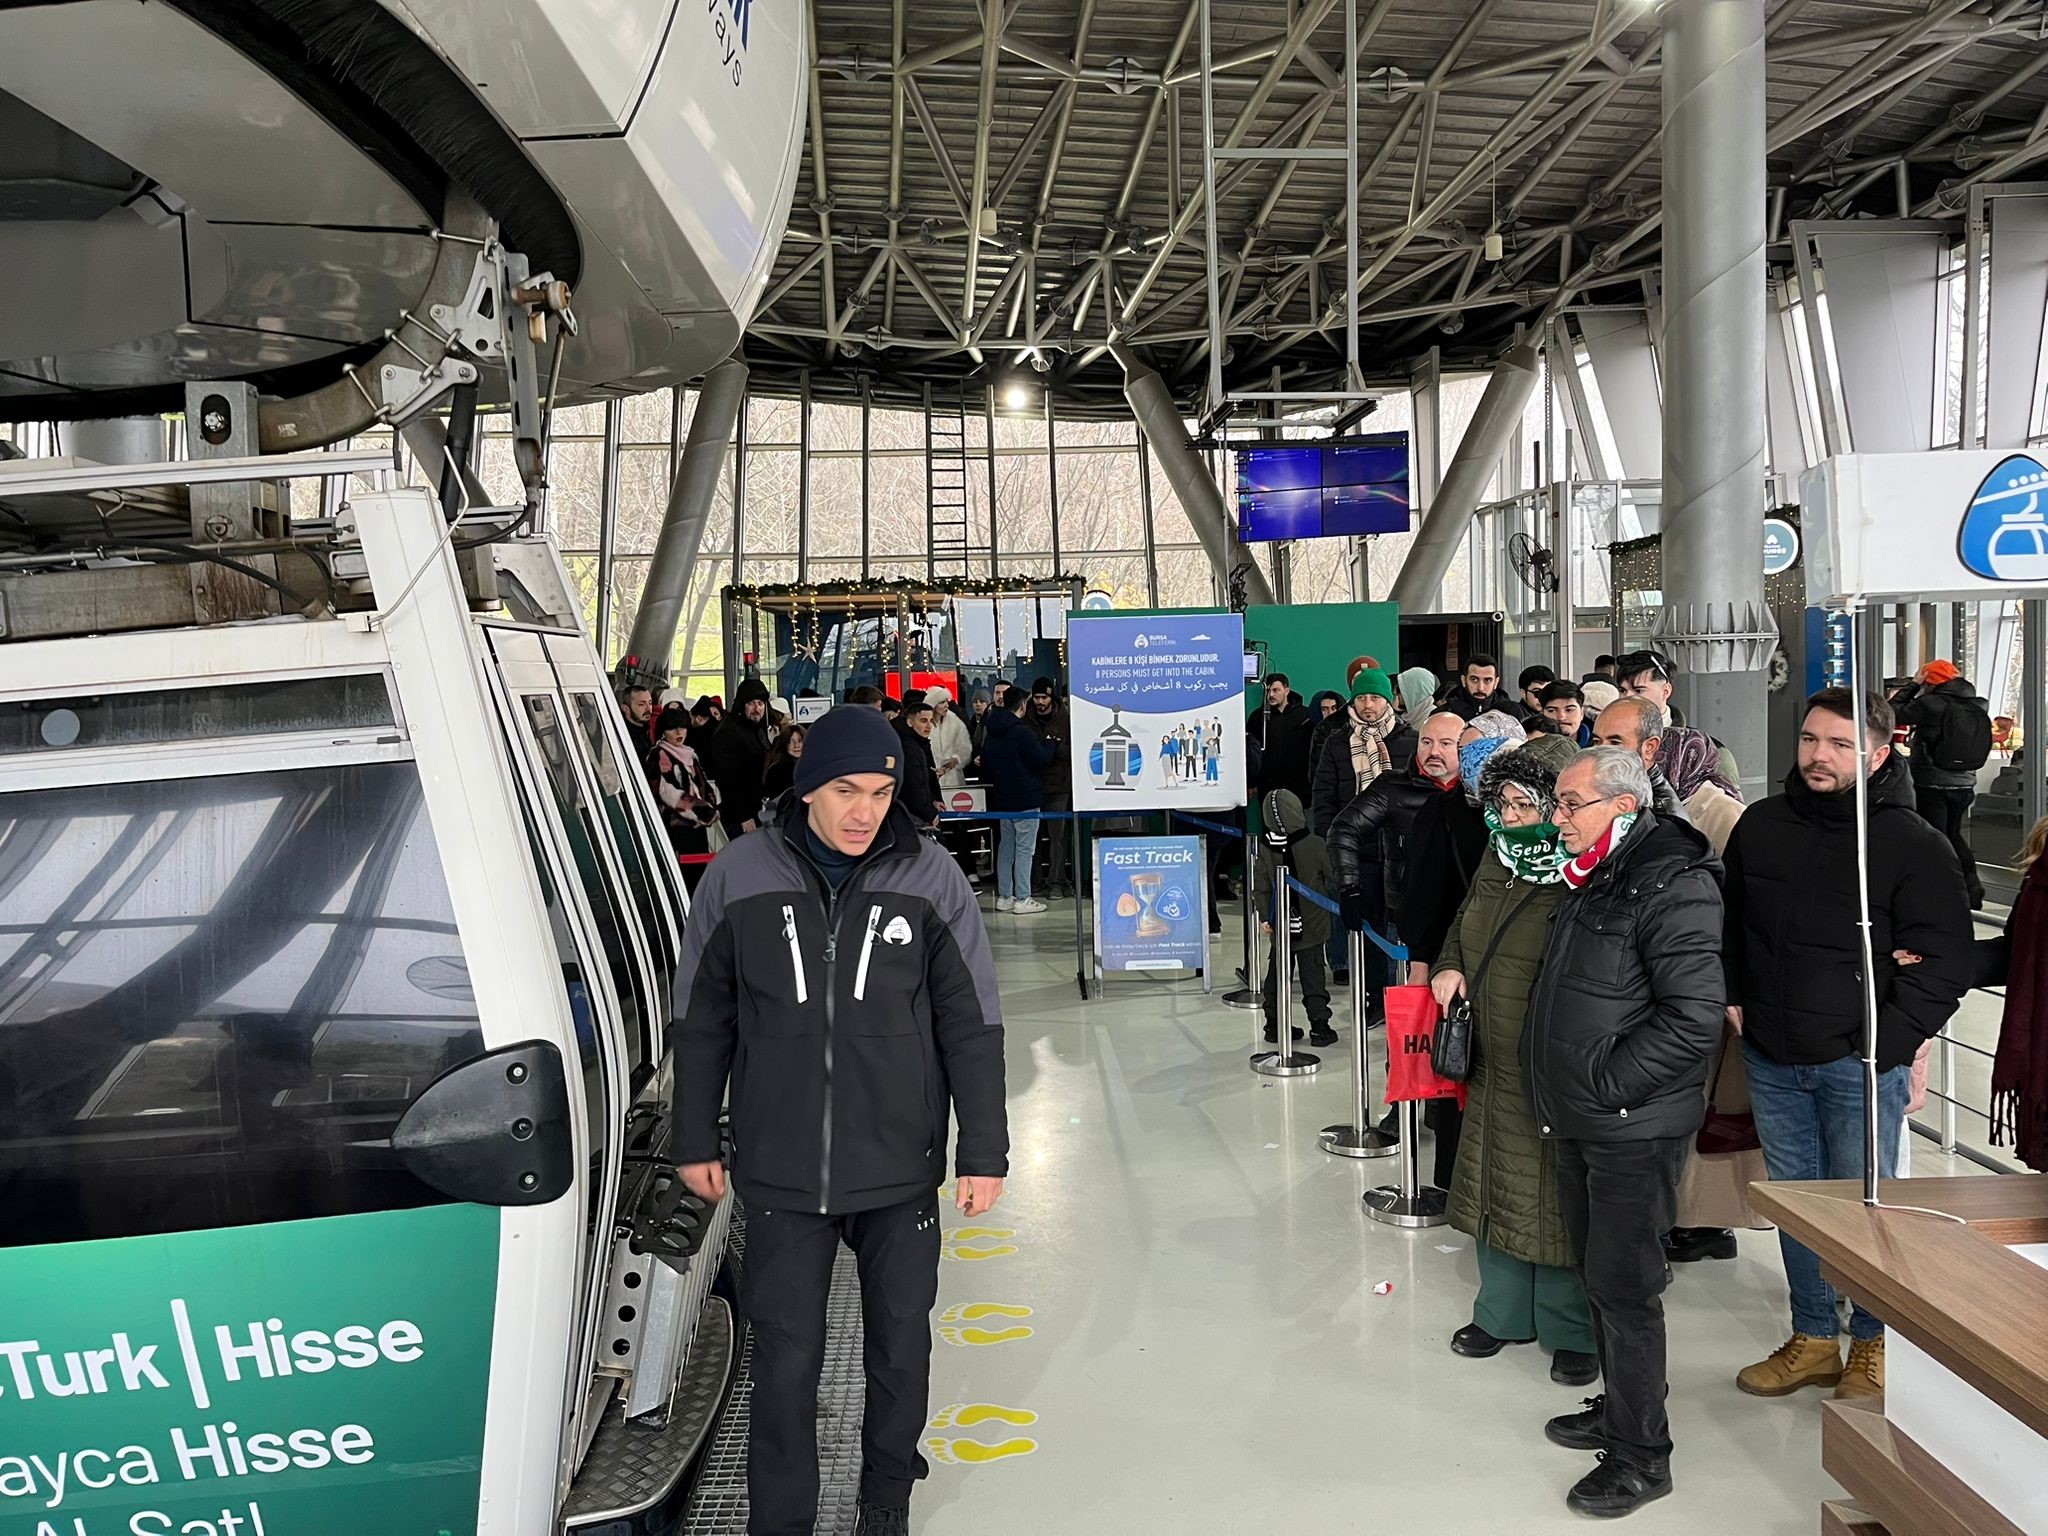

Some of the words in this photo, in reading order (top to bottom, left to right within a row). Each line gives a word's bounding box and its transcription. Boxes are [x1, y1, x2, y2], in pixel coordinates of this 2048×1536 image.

[1091, 655, 1128, 666] KABİNLERE
[1128, 656, 1133, 665] 8
[1134, 653, 1148, 666] KİŞİ
[1148, 653, 1174, 665] BİNMEK
[1175, 653, 1220, 664] ZORUNLUDUR.
[1095, 669, 1100, 679] 8
[1101, 669, 1131, 679] PERSONS
[1132, 668, 1151, 678] MUST
[1151, 668, 1163, 677] GET
[1165, 667, 1180, 677] INTO
[1181, 667, 1194, 676] THE
[1194, 666, 1217, 676] CABIN.
[1084, 683, 1115, 695] مقصورة
[1117, 681, 1129, 693] كل
[1131, 681, 1139, 695] في
[1141, 679, 1173, 693] أشخاص
[1175, 681, 1181, 689] 8
[1184, 679, 1206, 692] ركوب
[1208, 681, 1228, 691] يجب
[1103, 851, 1141, 865] Fast
[1145, 849, 1193, 864] Track
[0, 1331, 170, 1401] Turk
[214, 1317, 425, 1382] Hisse
[170, 1421, 376, 1481] Hisse
